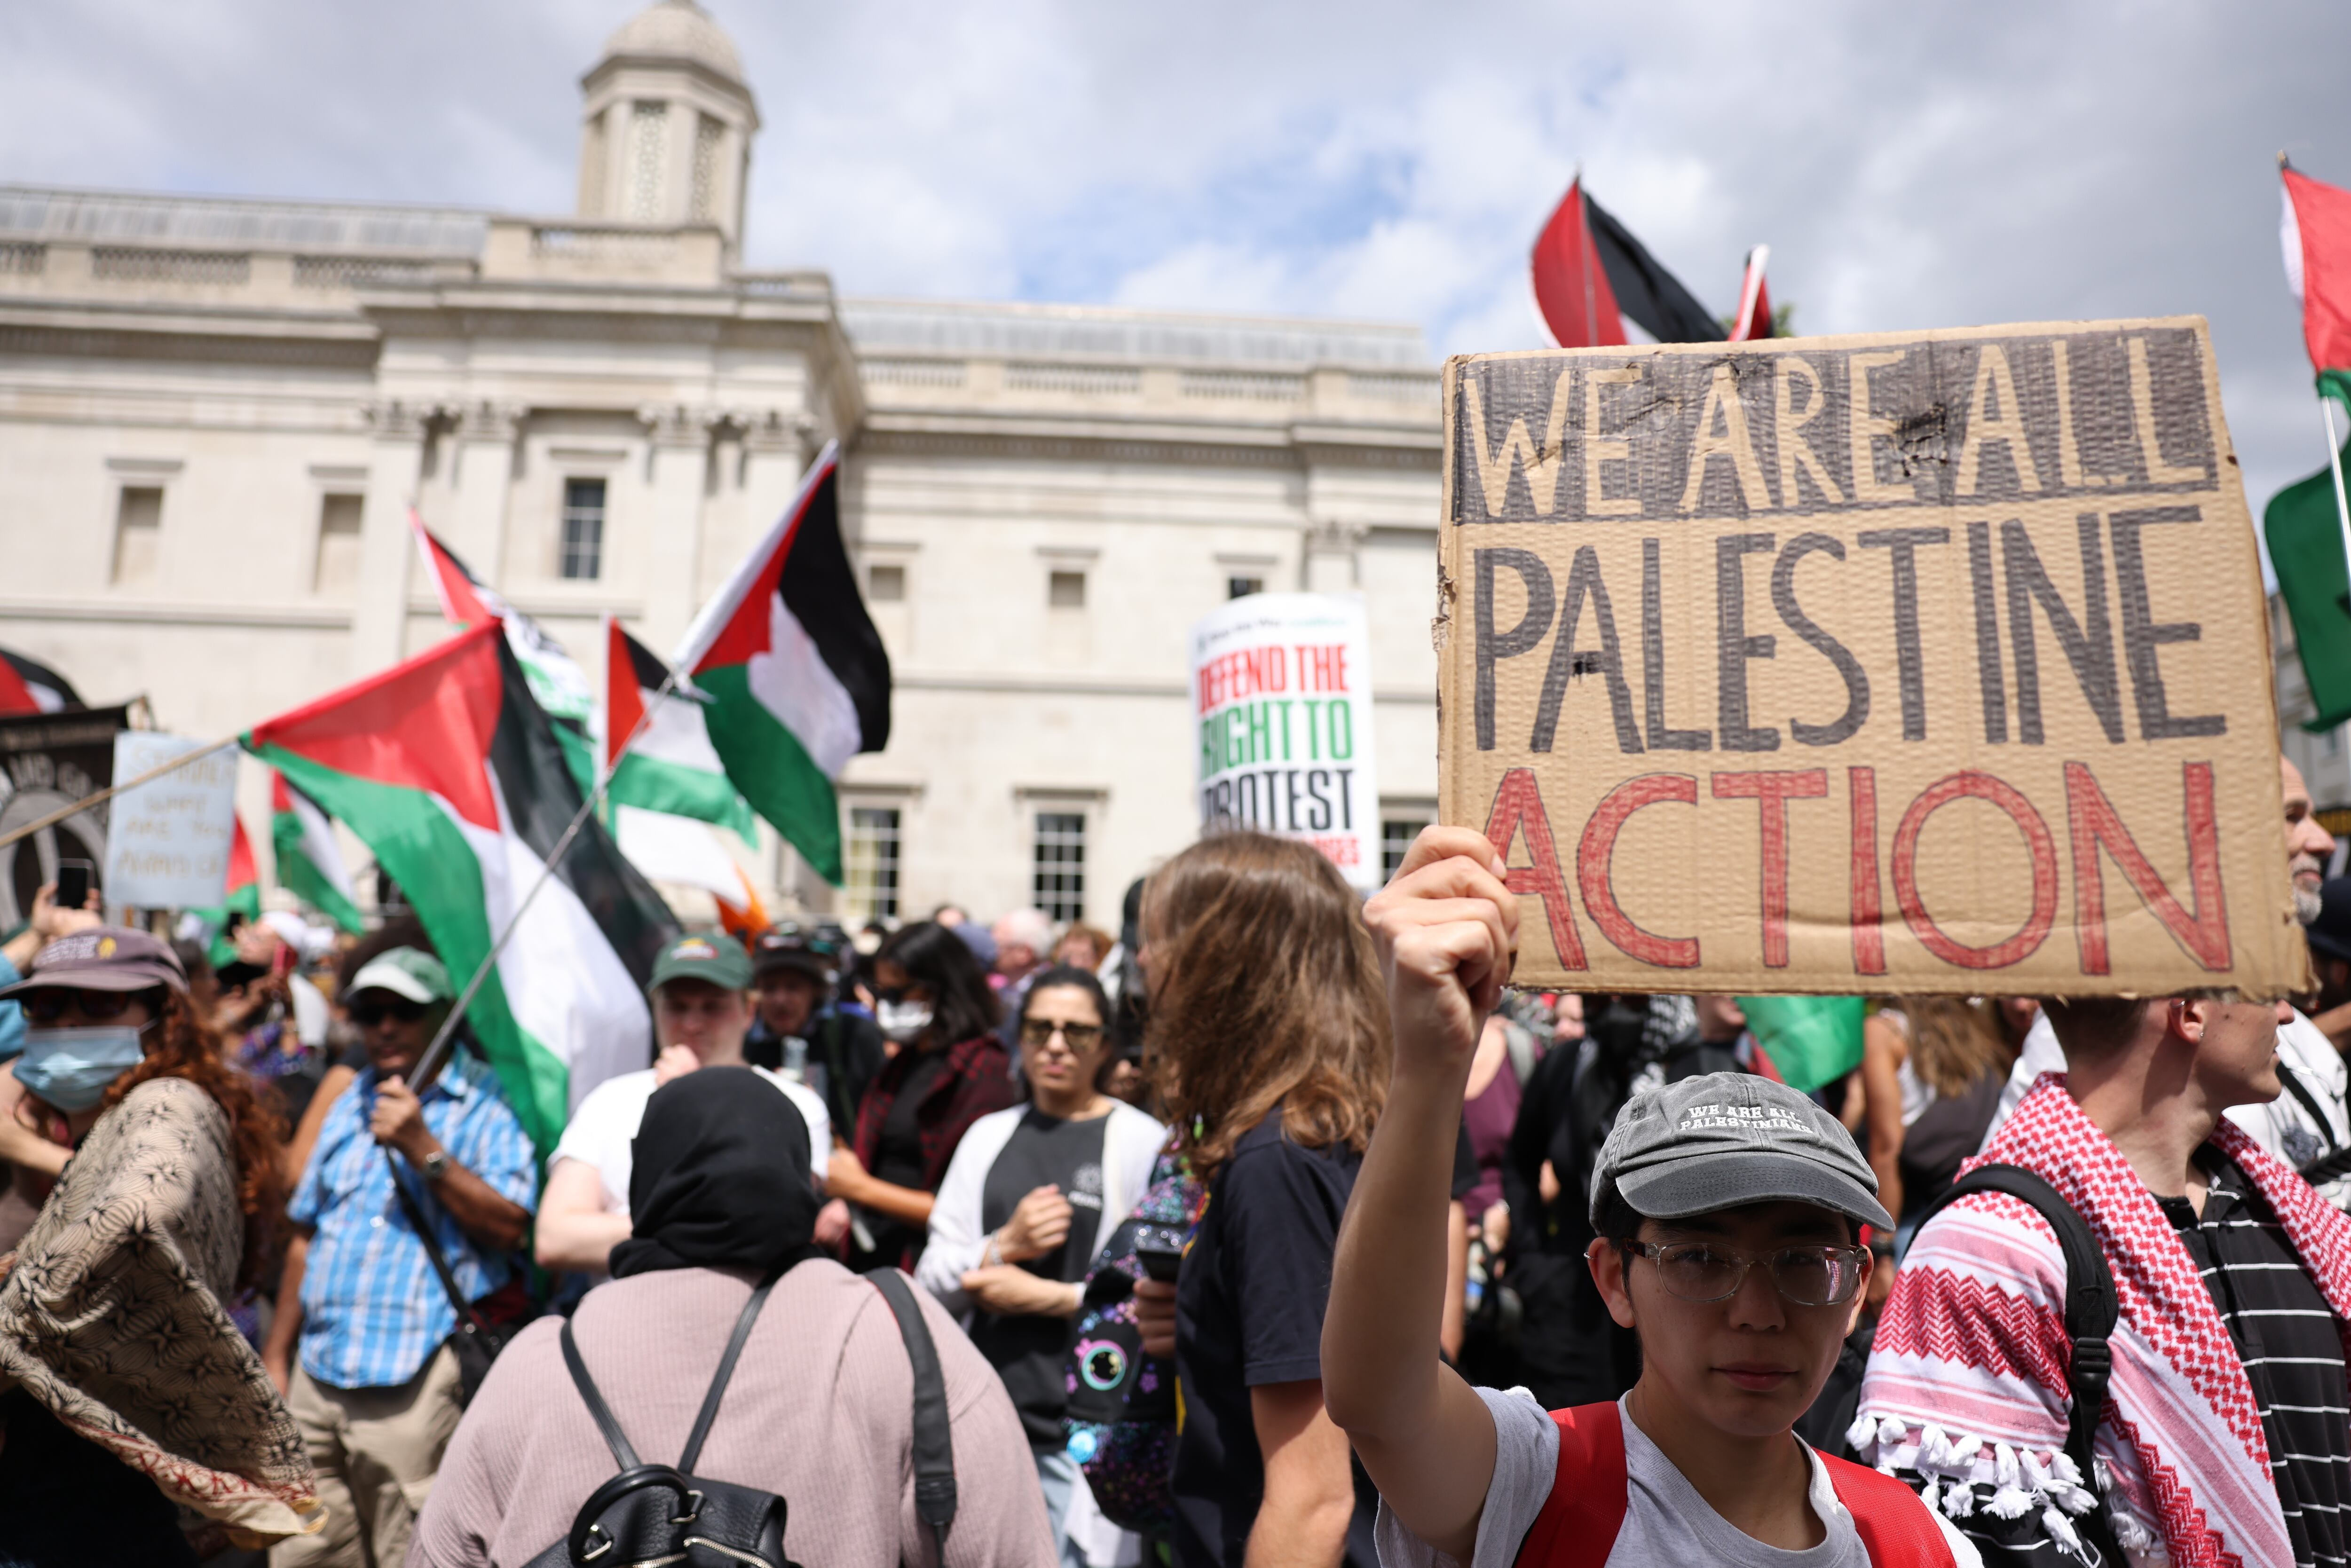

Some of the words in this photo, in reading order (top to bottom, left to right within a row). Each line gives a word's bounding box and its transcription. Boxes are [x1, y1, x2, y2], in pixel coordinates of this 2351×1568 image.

[1464, 363, 1642, 517] WE
[1679, 350, 1908, 512] ARE
[1955, 337, 2205, 496] ALL
[1474, 504, 2227, 753] PALESTINE
[1198, 645, 1286, 715] DEFEND
[1294, 643, 1349, 693] THE
[1200, 700, 1293, 781] RIGHT
[1303, 699, 1353, 761] TO
[1484, 761, 2232, 976] ACTION
[1680, 1116, 1814, 1134] PALESTINIANS
[1688, 1104, 1720, 1119] WE
[1727, 1105, 1764, 1119] ARE
[1769, 1107, 1802, 1123] ALL
